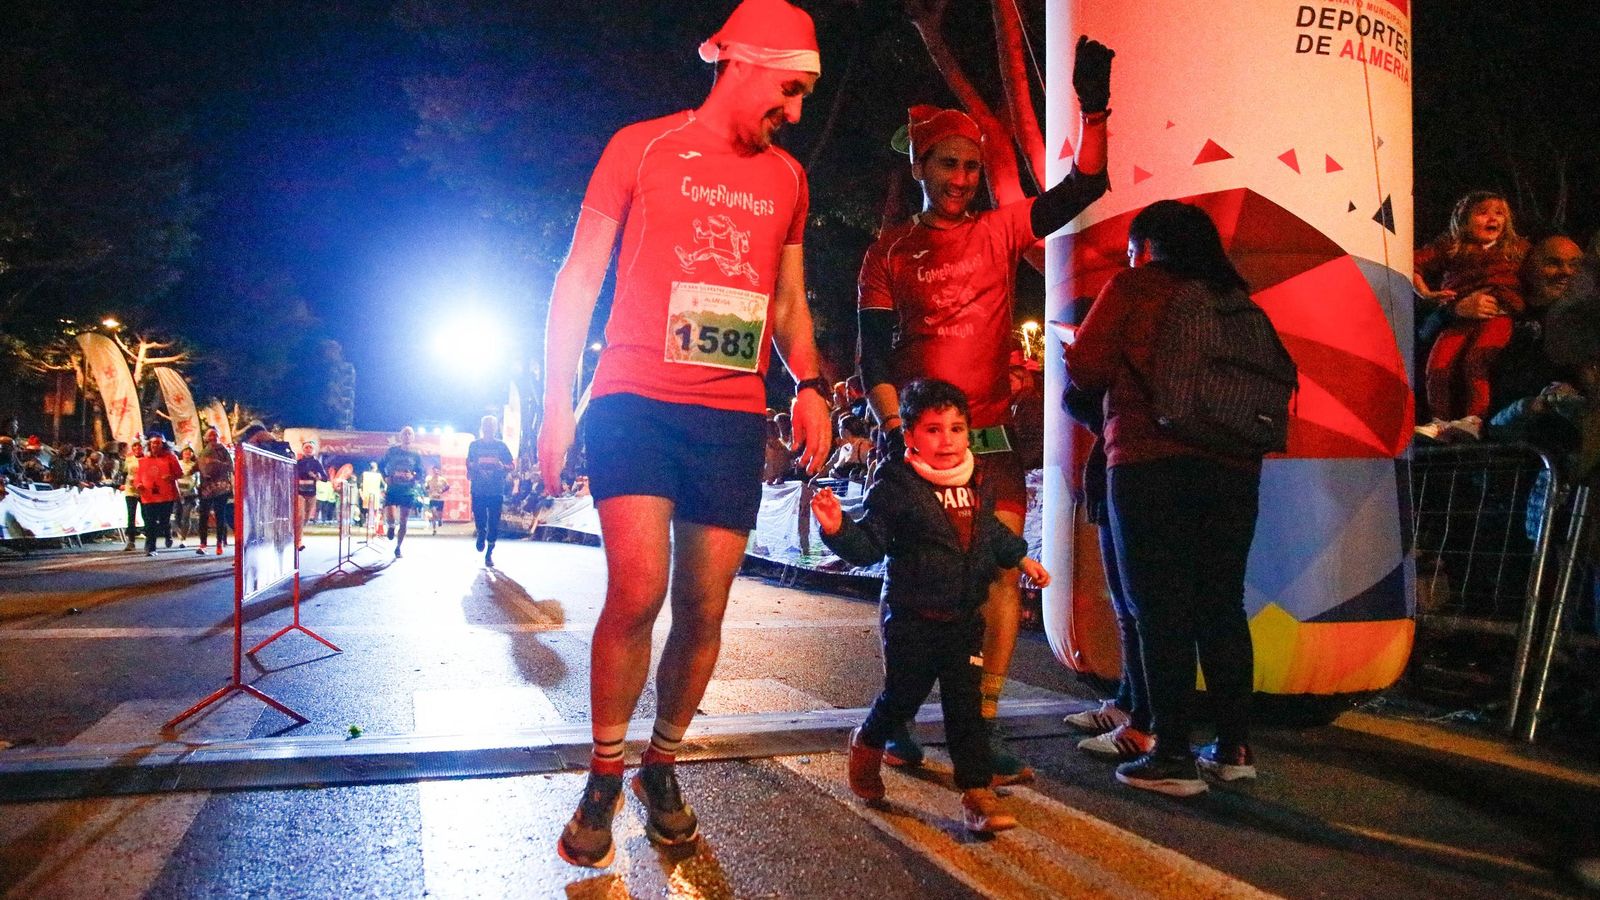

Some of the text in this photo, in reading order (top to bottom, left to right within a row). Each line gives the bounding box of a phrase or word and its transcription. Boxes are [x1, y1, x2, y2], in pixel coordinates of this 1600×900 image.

[1295, 34, 1333, 56] DE
[1296, 5, 1409, 60] DEPORTES
[675, 324, 754, 359] 1583
